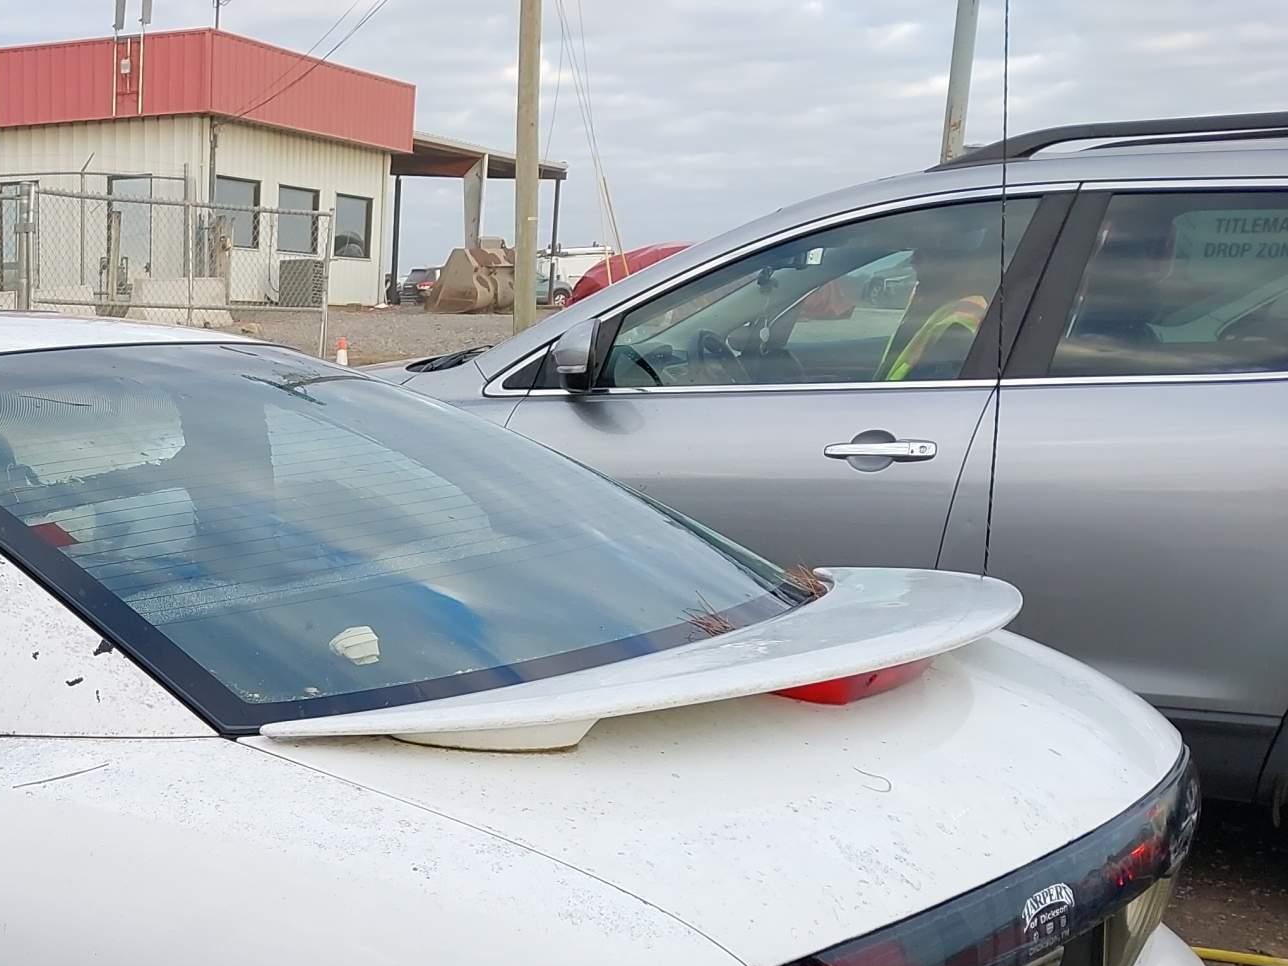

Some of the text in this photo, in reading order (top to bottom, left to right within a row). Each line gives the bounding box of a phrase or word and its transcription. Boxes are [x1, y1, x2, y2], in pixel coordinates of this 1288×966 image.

[1203, 242, 1253, 259] DROP
[1030, 904, 1068, 929] of Dickson
